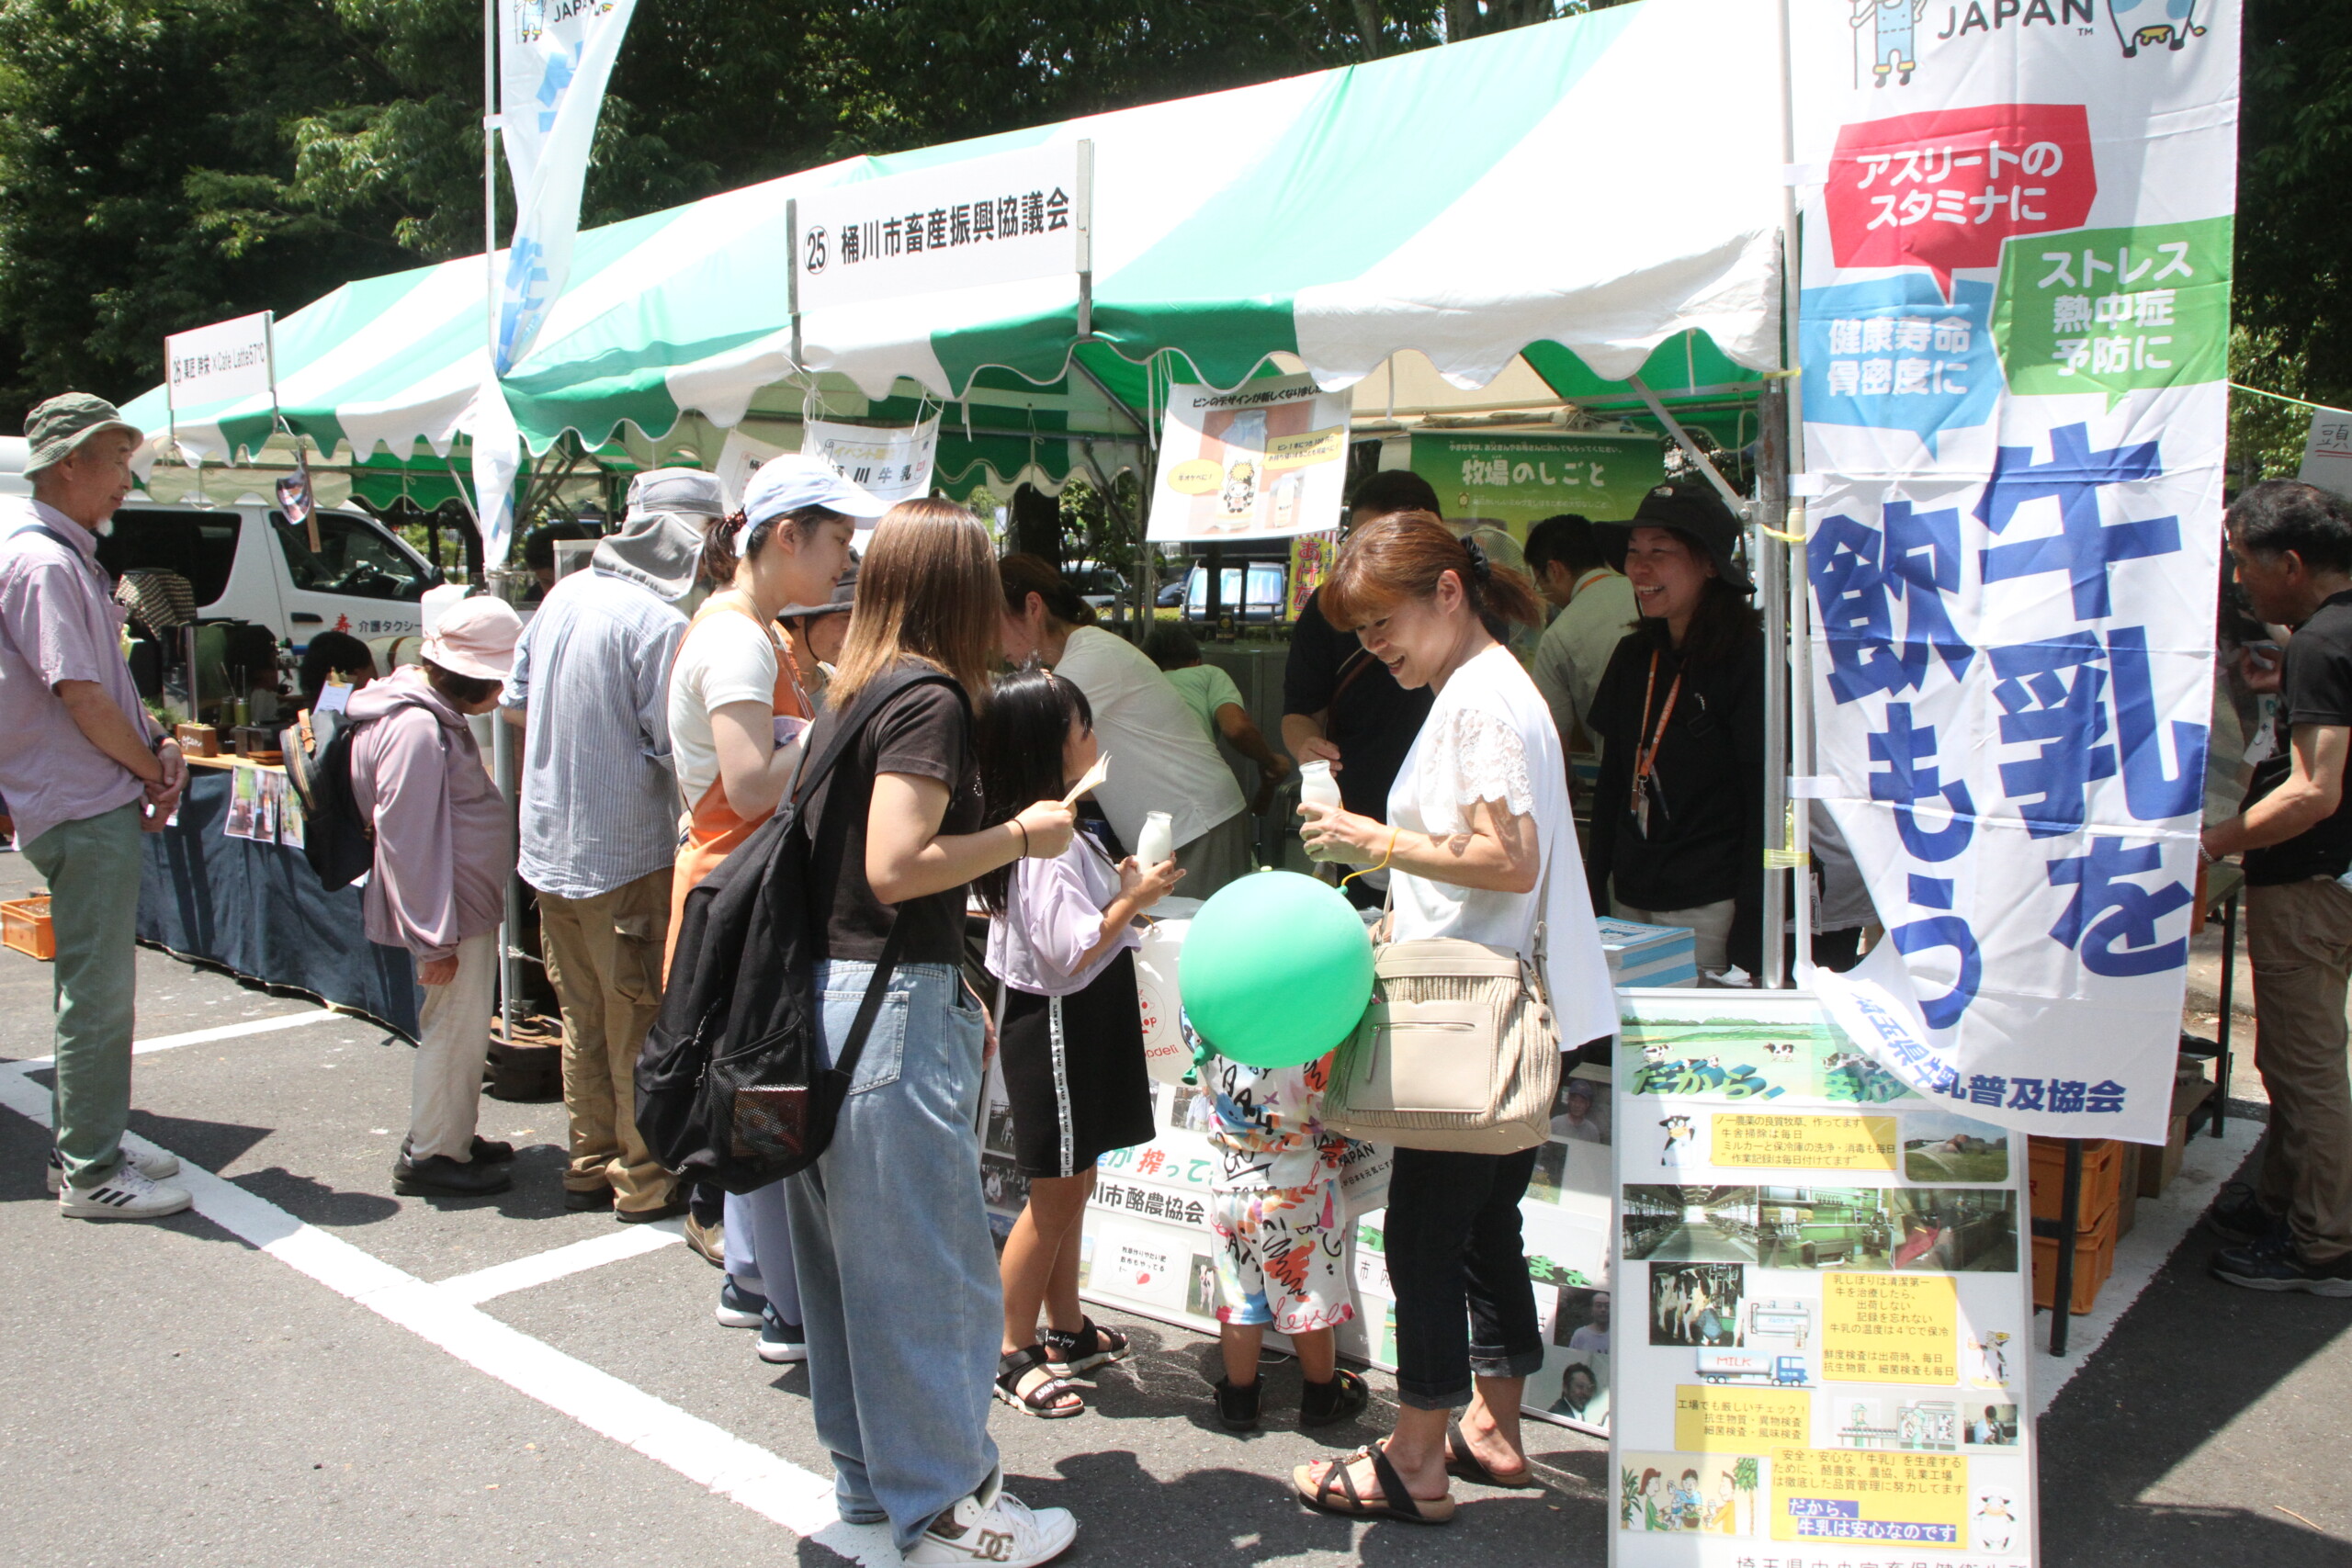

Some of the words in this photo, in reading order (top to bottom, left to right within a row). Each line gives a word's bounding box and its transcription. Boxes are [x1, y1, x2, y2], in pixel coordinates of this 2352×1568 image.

[1939, 0, 2093, 39] JAPAN
[1856, 140, 2064, 190] アスリートの
[1866, 184, 2047, 231] スタミナに
[841, 186, 1069, 265] 桶川市畜産振興協議会
[2037, 240, 2194, 289] ストレス
[2052, 288, 2177, 334] 熱中症
[1828, 315, 1972, 355] 健康寿命
[2052, 334, 2172, 377] 予防に
[1826, 358, 1968, 397] 骨密度に
[1462, 459, 1606, 487] 牧場のしごと
[359, 619, 422, 634] 介護タクシー
[1975, 421, 2209, 978] 牛乳を
[1806, 498, 1984, 1032] 飲もう
[1097, 1145, 1214, 1187] が搾って
[1833, 1275, 1930, 1287] 乳しぼりは清潔第一
[1836, 1288, 1916, 1300] 牛を治療したら、
[1857, 1301, 1911, 1311] 出荷しない
[1857, 1313, 1932, 1324] 記録を忘れない
[1716, 1357, 1751, 1367] MILK
[1824, 1348, 1943, 1363] 鮮度検査は出荷時、毎日
[1824, 1362, 1954, 1376] 抗生物質、細菌検査も毎日
[1704, 1414, 1802, 1427] 抗生物質・異物検査
[1703, 1426, 1802, 1439] 細菌検査・風味検査
[1782, 1450, 1962, 1468] 安全・安心な「牛乳」を生産する
[1773, 1463, 1953, 1482] ために、酪農家、農協、乳業工場
[1772, 1476, 1964, 1495] は徹底した品質管理に努力してます
[1790, 1499, 1849, 1517] だから、
[1798, 1517, 1956, 1540] 牛乳は安心なのです
